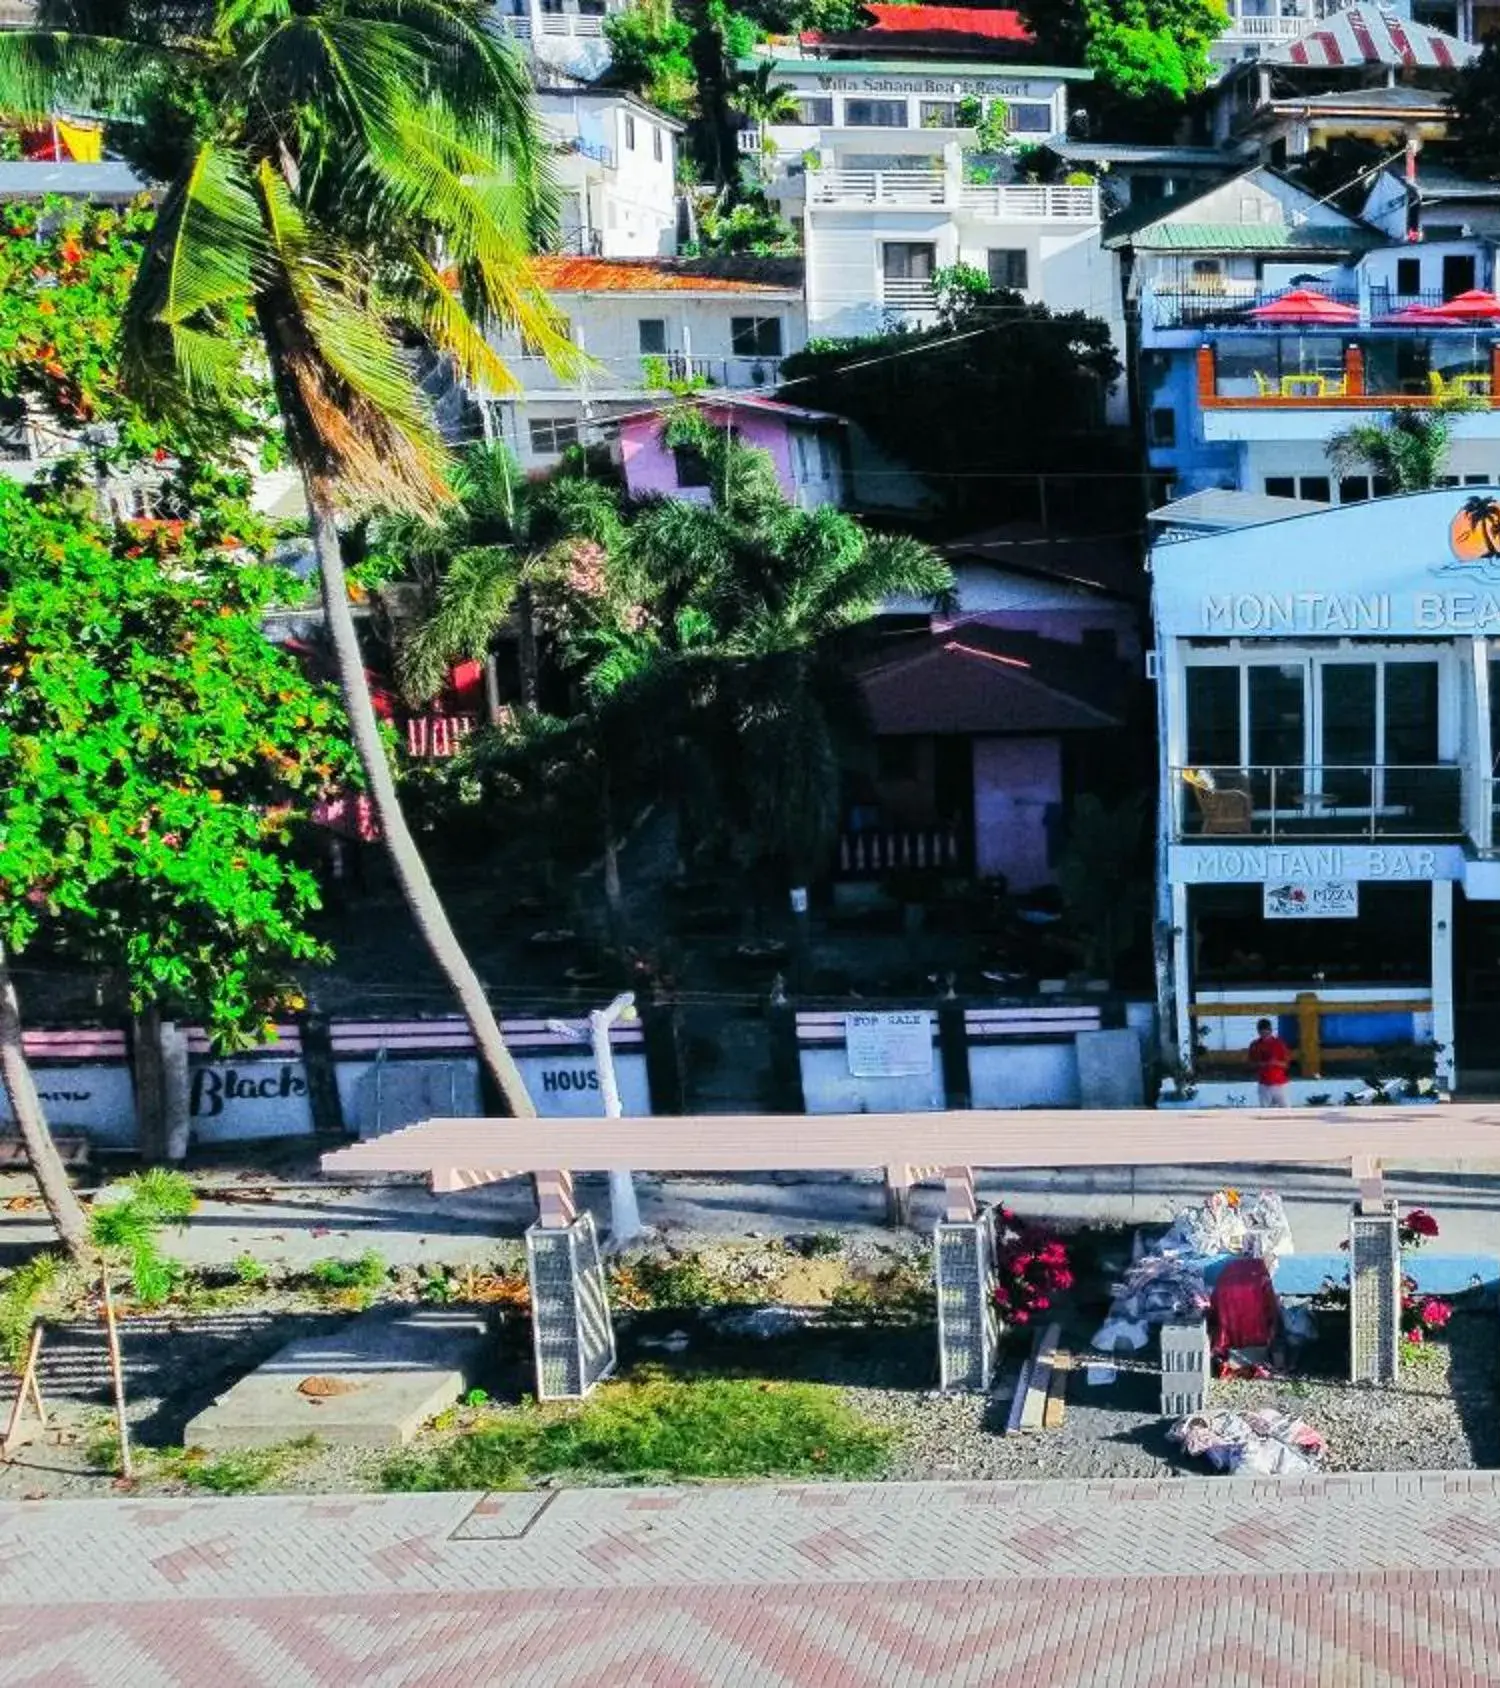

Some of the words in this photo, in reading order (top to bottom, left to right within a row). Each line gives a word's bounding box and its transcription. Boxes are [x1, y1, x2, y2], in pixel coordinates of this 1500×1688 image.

[818, 74, 858, 91] Villa
[925, 78, 971, 95] Beah
[1201, 591, 1392, 632] MONTANI
[1194, 847, 1344, 879] MONTANI
[1368, 848, 1437, 878] BAR
[1312, 889, 1356, 902] PIZZA
[853, 1015, 880, 1027] FOR
[887, 1015, 921, 1026] SALE
[189, 1066, 309, 1118] Black
[541, 1068, 600, 1092] HOUS
